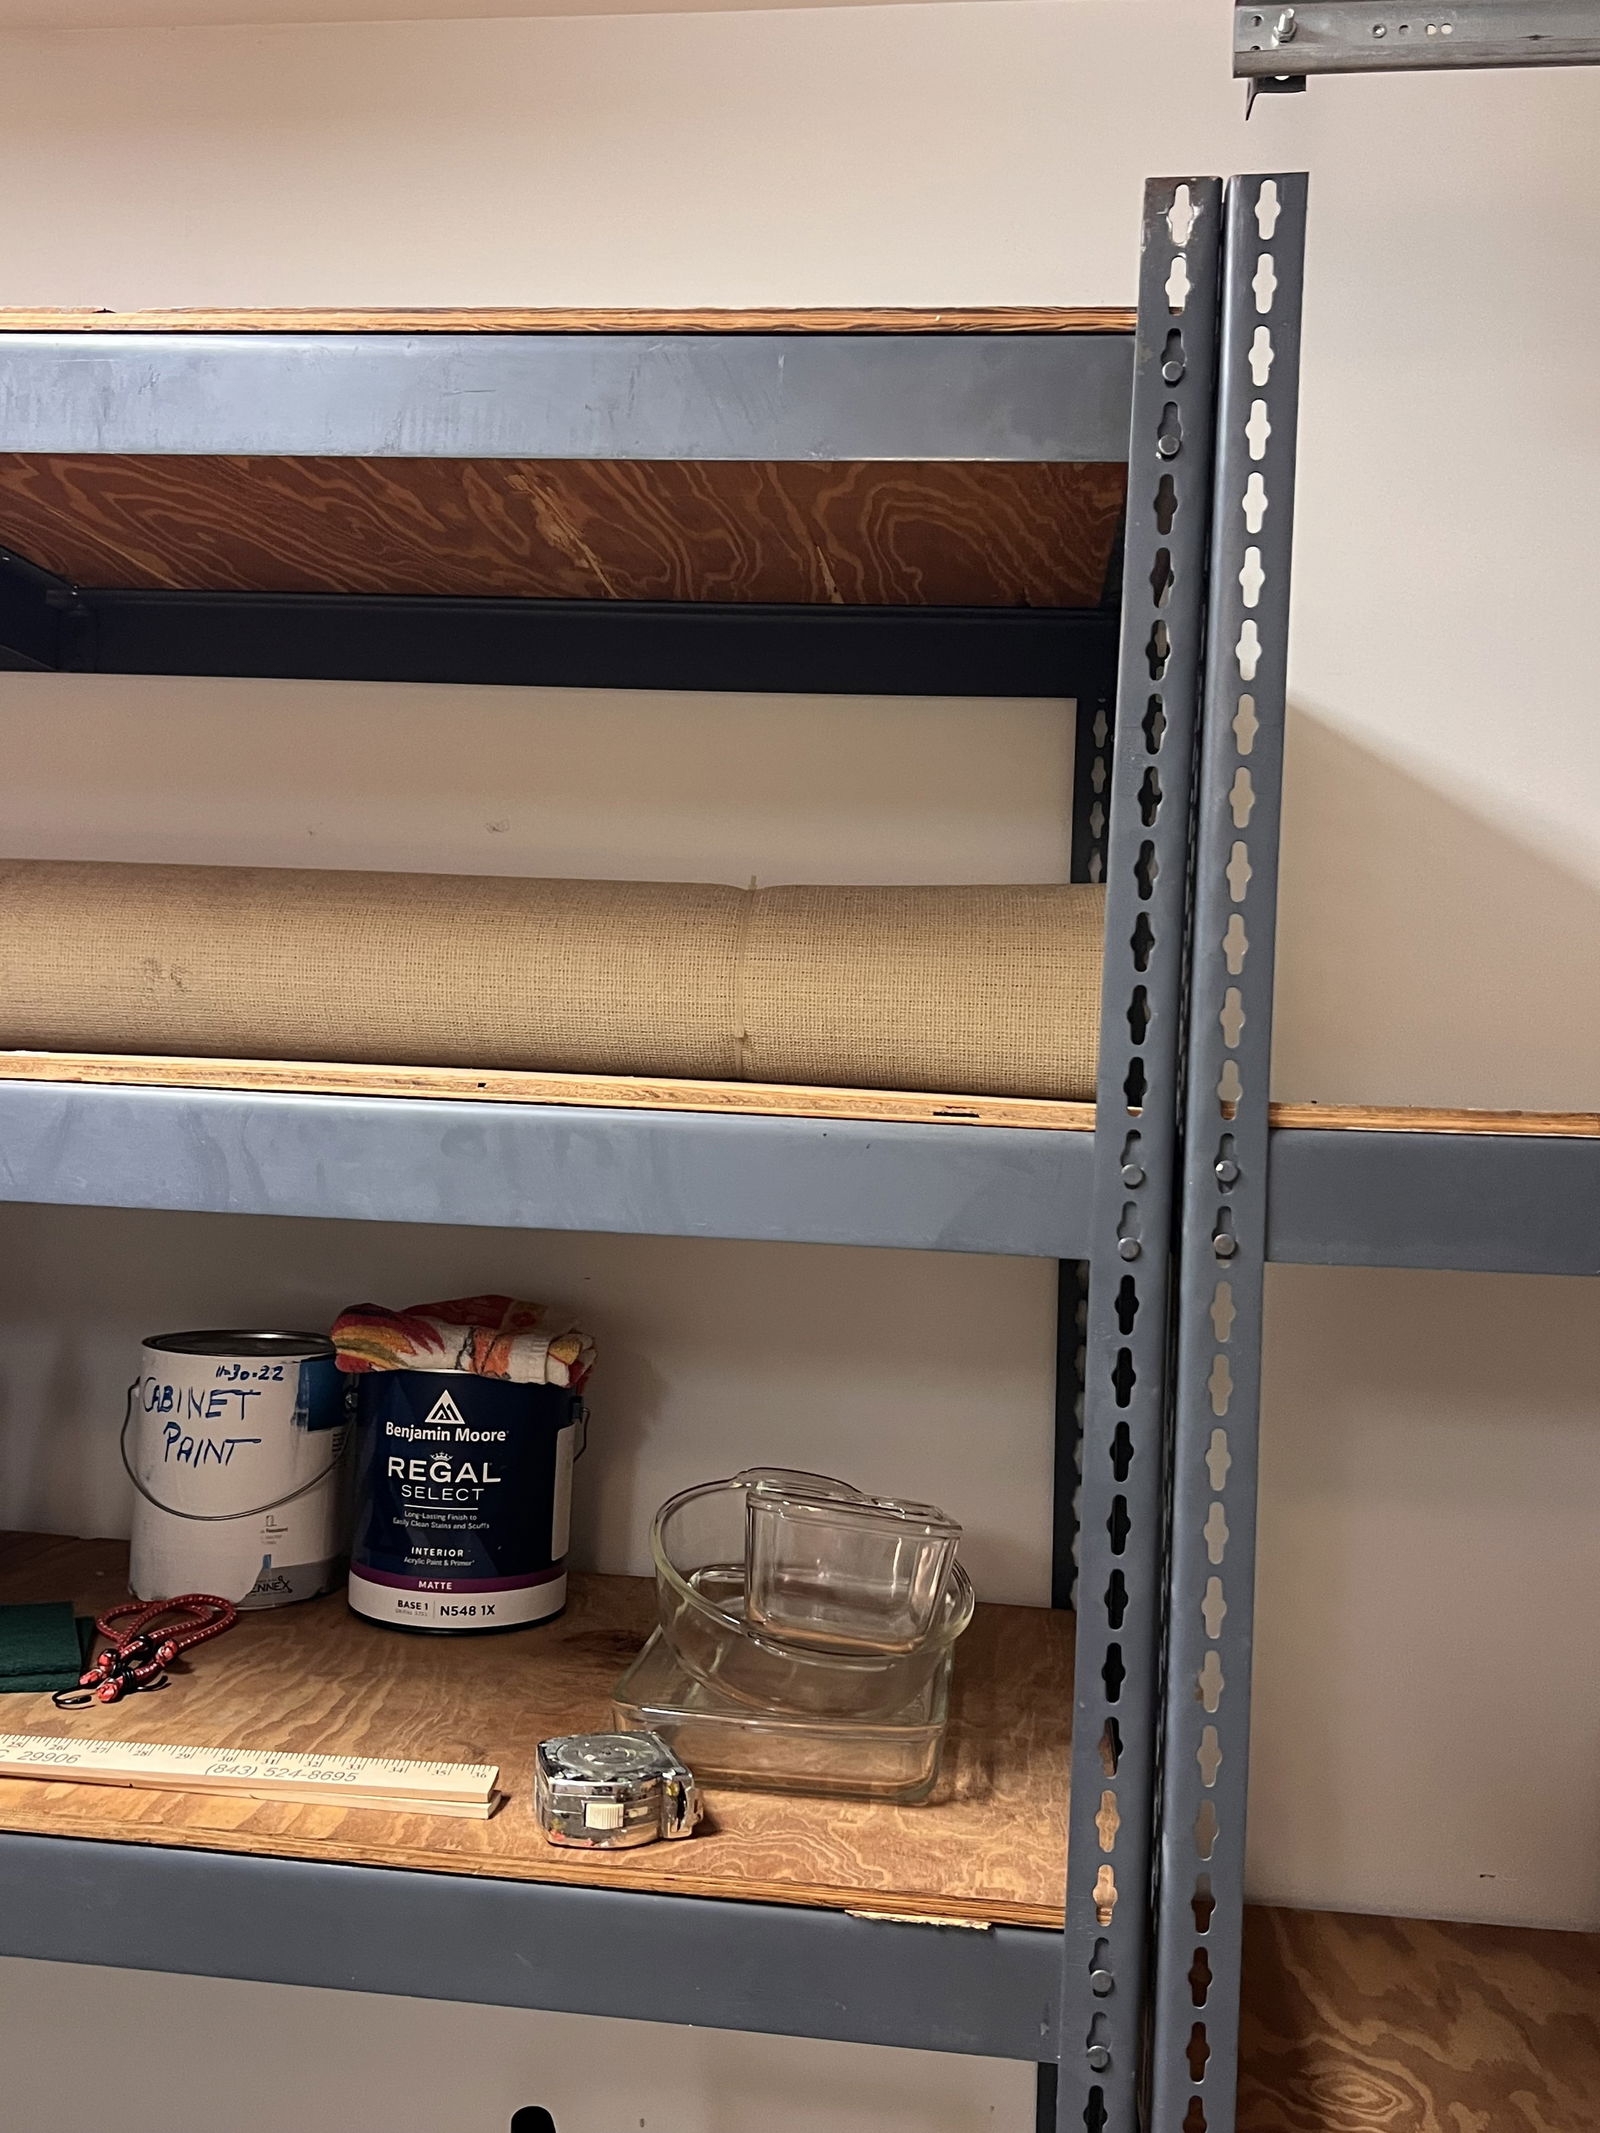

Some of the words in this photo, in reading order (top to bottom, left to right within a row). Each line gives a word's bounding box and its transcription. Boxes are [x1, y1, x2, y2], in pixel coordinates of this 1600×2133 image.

[142, 1376, 262, 1421] CABINET
[385, 1422, 451, 1443] Benjamin
[455, 1428, 507, 1442] Moore
[162, 1421, 262, 1469] PAINT
[387, 1456, 502, 1484] REGAL
[401, 1484, 485, 1501] SELECT
[410, 1520, 430, 1528] Clean
[430, 1521, 452, 1530] Stains
[411, 1546, 465, 1558] INTERIOR
[418, 1580, 453, 1591] MATTE
[397, 1599, 422, 1611] BASE
[423, 1602, 429, 1611] 1
[440, 1605, 477, 1617] N548
[480, 1604, 496, 1616] 1X
[17, 1750, 82, 1764] 29906
[204, 1763, 258, 1777] (843)
[263, 1767, 359, 1782] 524-8695
